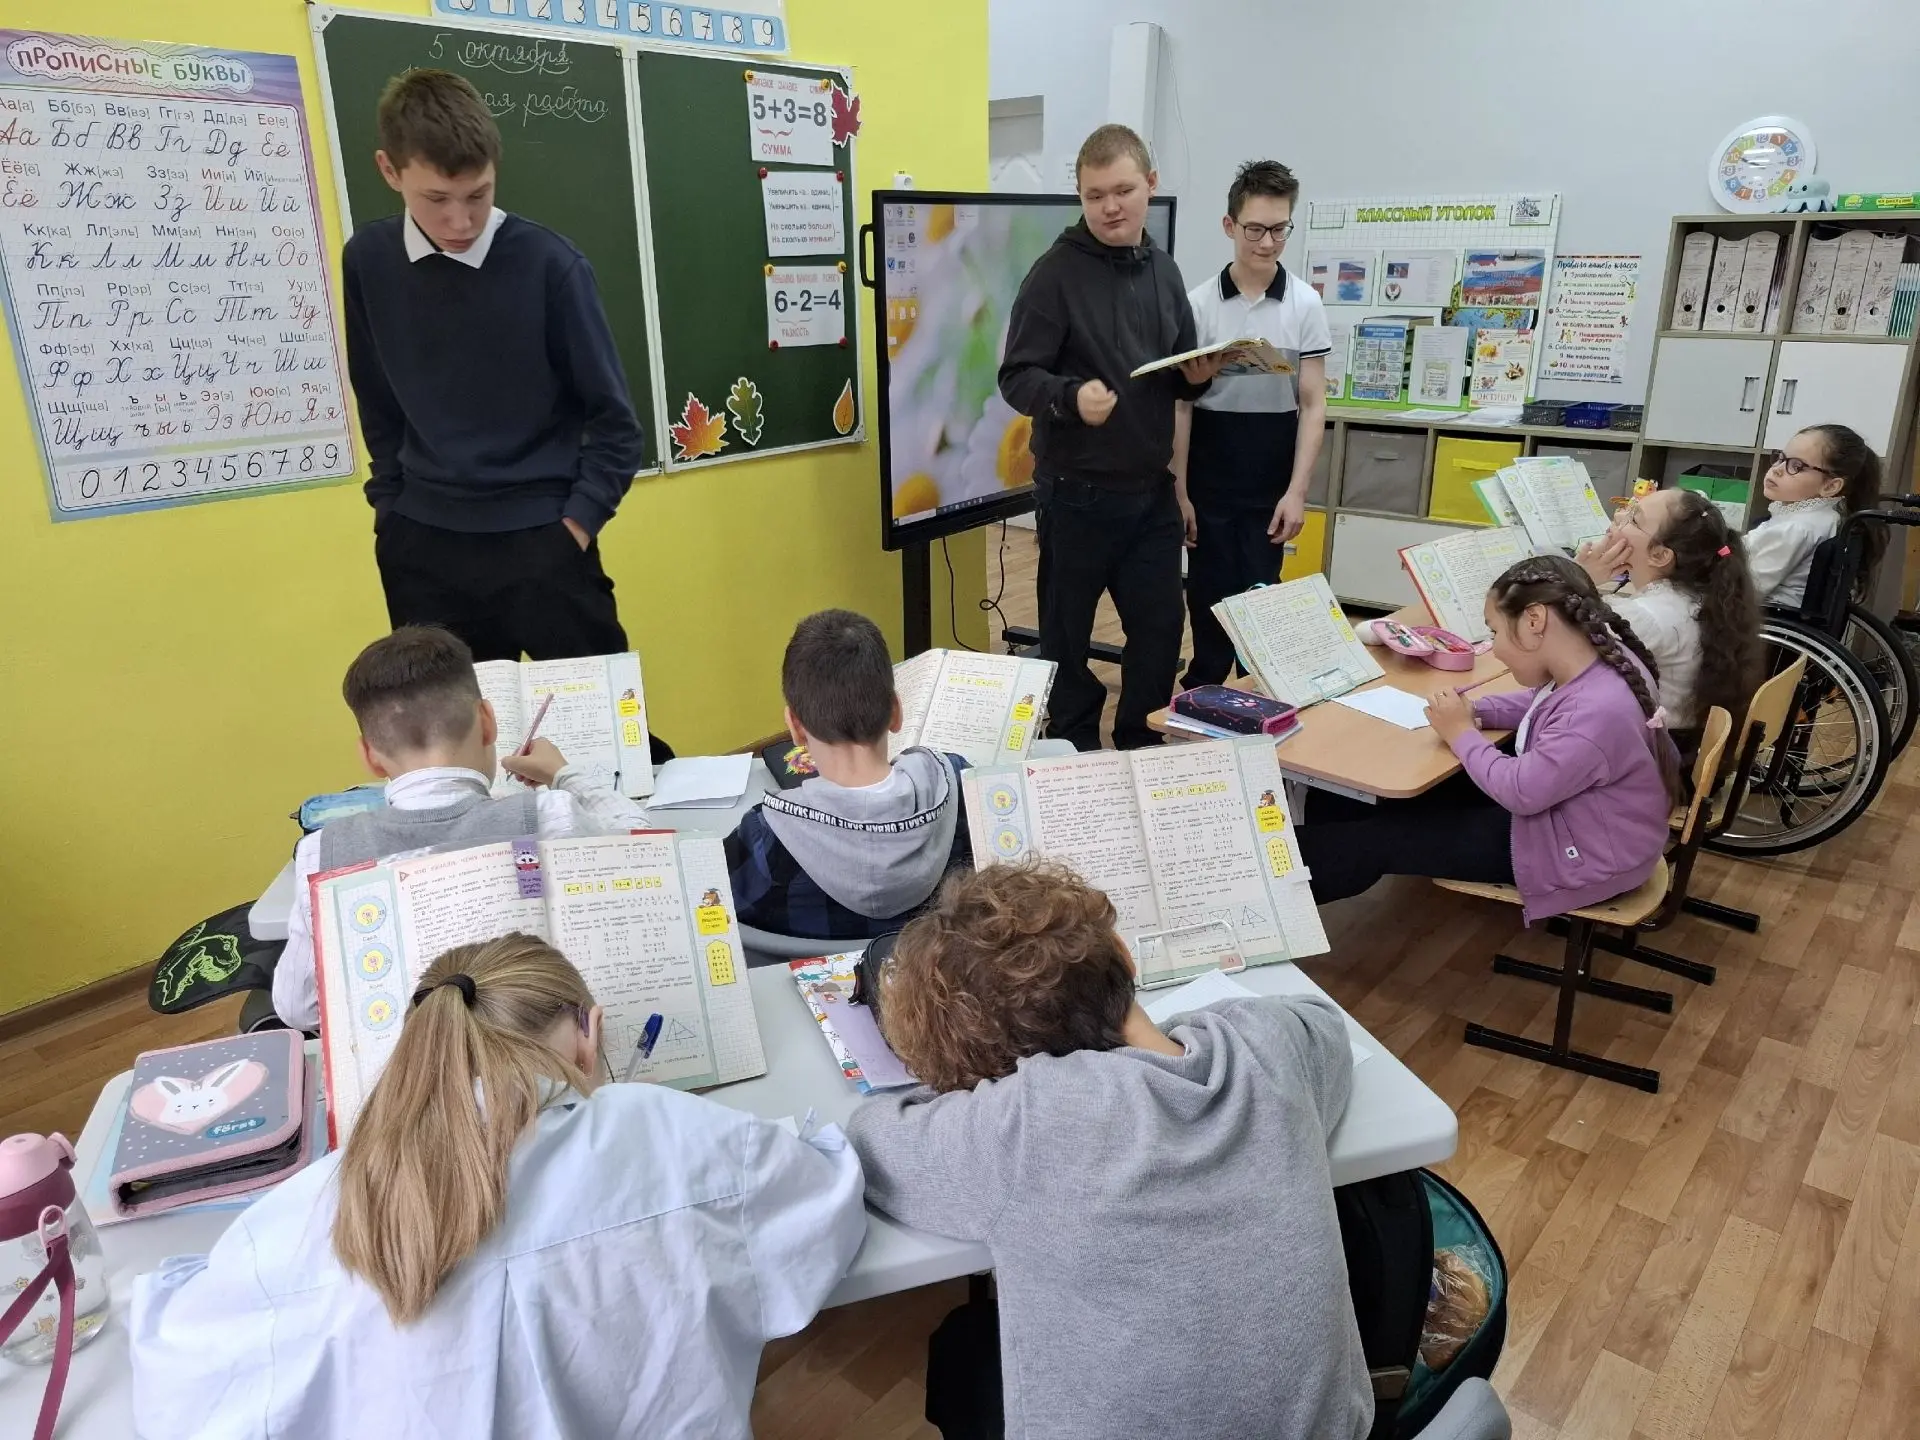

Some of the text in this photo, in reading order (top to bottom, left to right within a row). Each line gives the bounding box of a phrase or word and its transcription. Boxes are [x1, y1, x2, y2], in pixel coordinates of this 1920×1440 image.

[538, 0, 551, 20] 2
[573, 2, 586, 24] 3
[606, 2, 618, 29] 4
[636, 5, 651, 32] 5
[669, 9, 683, 36] 6
[699, 12, 713, 40] 7
[732, 16, 744, 44] 8
[762, 19, 774, 46] 9
[428, 33, 452, 60] 5
[17, 47, 246, 84] ПРОПИСНЫЕ БУКВЫ
[762, 143, 792, 156] СУММА
[1356, 205, 1433, 223] КЛАССНЫЙ
[1436, 204, 1497, 221] УГОЛОК
[1557, 260, 1587, 272] Правила
[1614, 261, 1638, 270] класса
[81, 444, 338, 498] 0 1 2 3 4 5 6 7 8 9
[785, 801, 809, 818] SKATE
[808, 809, 837, 826] URBAN
[865, 823, 898, 833] URBAN
